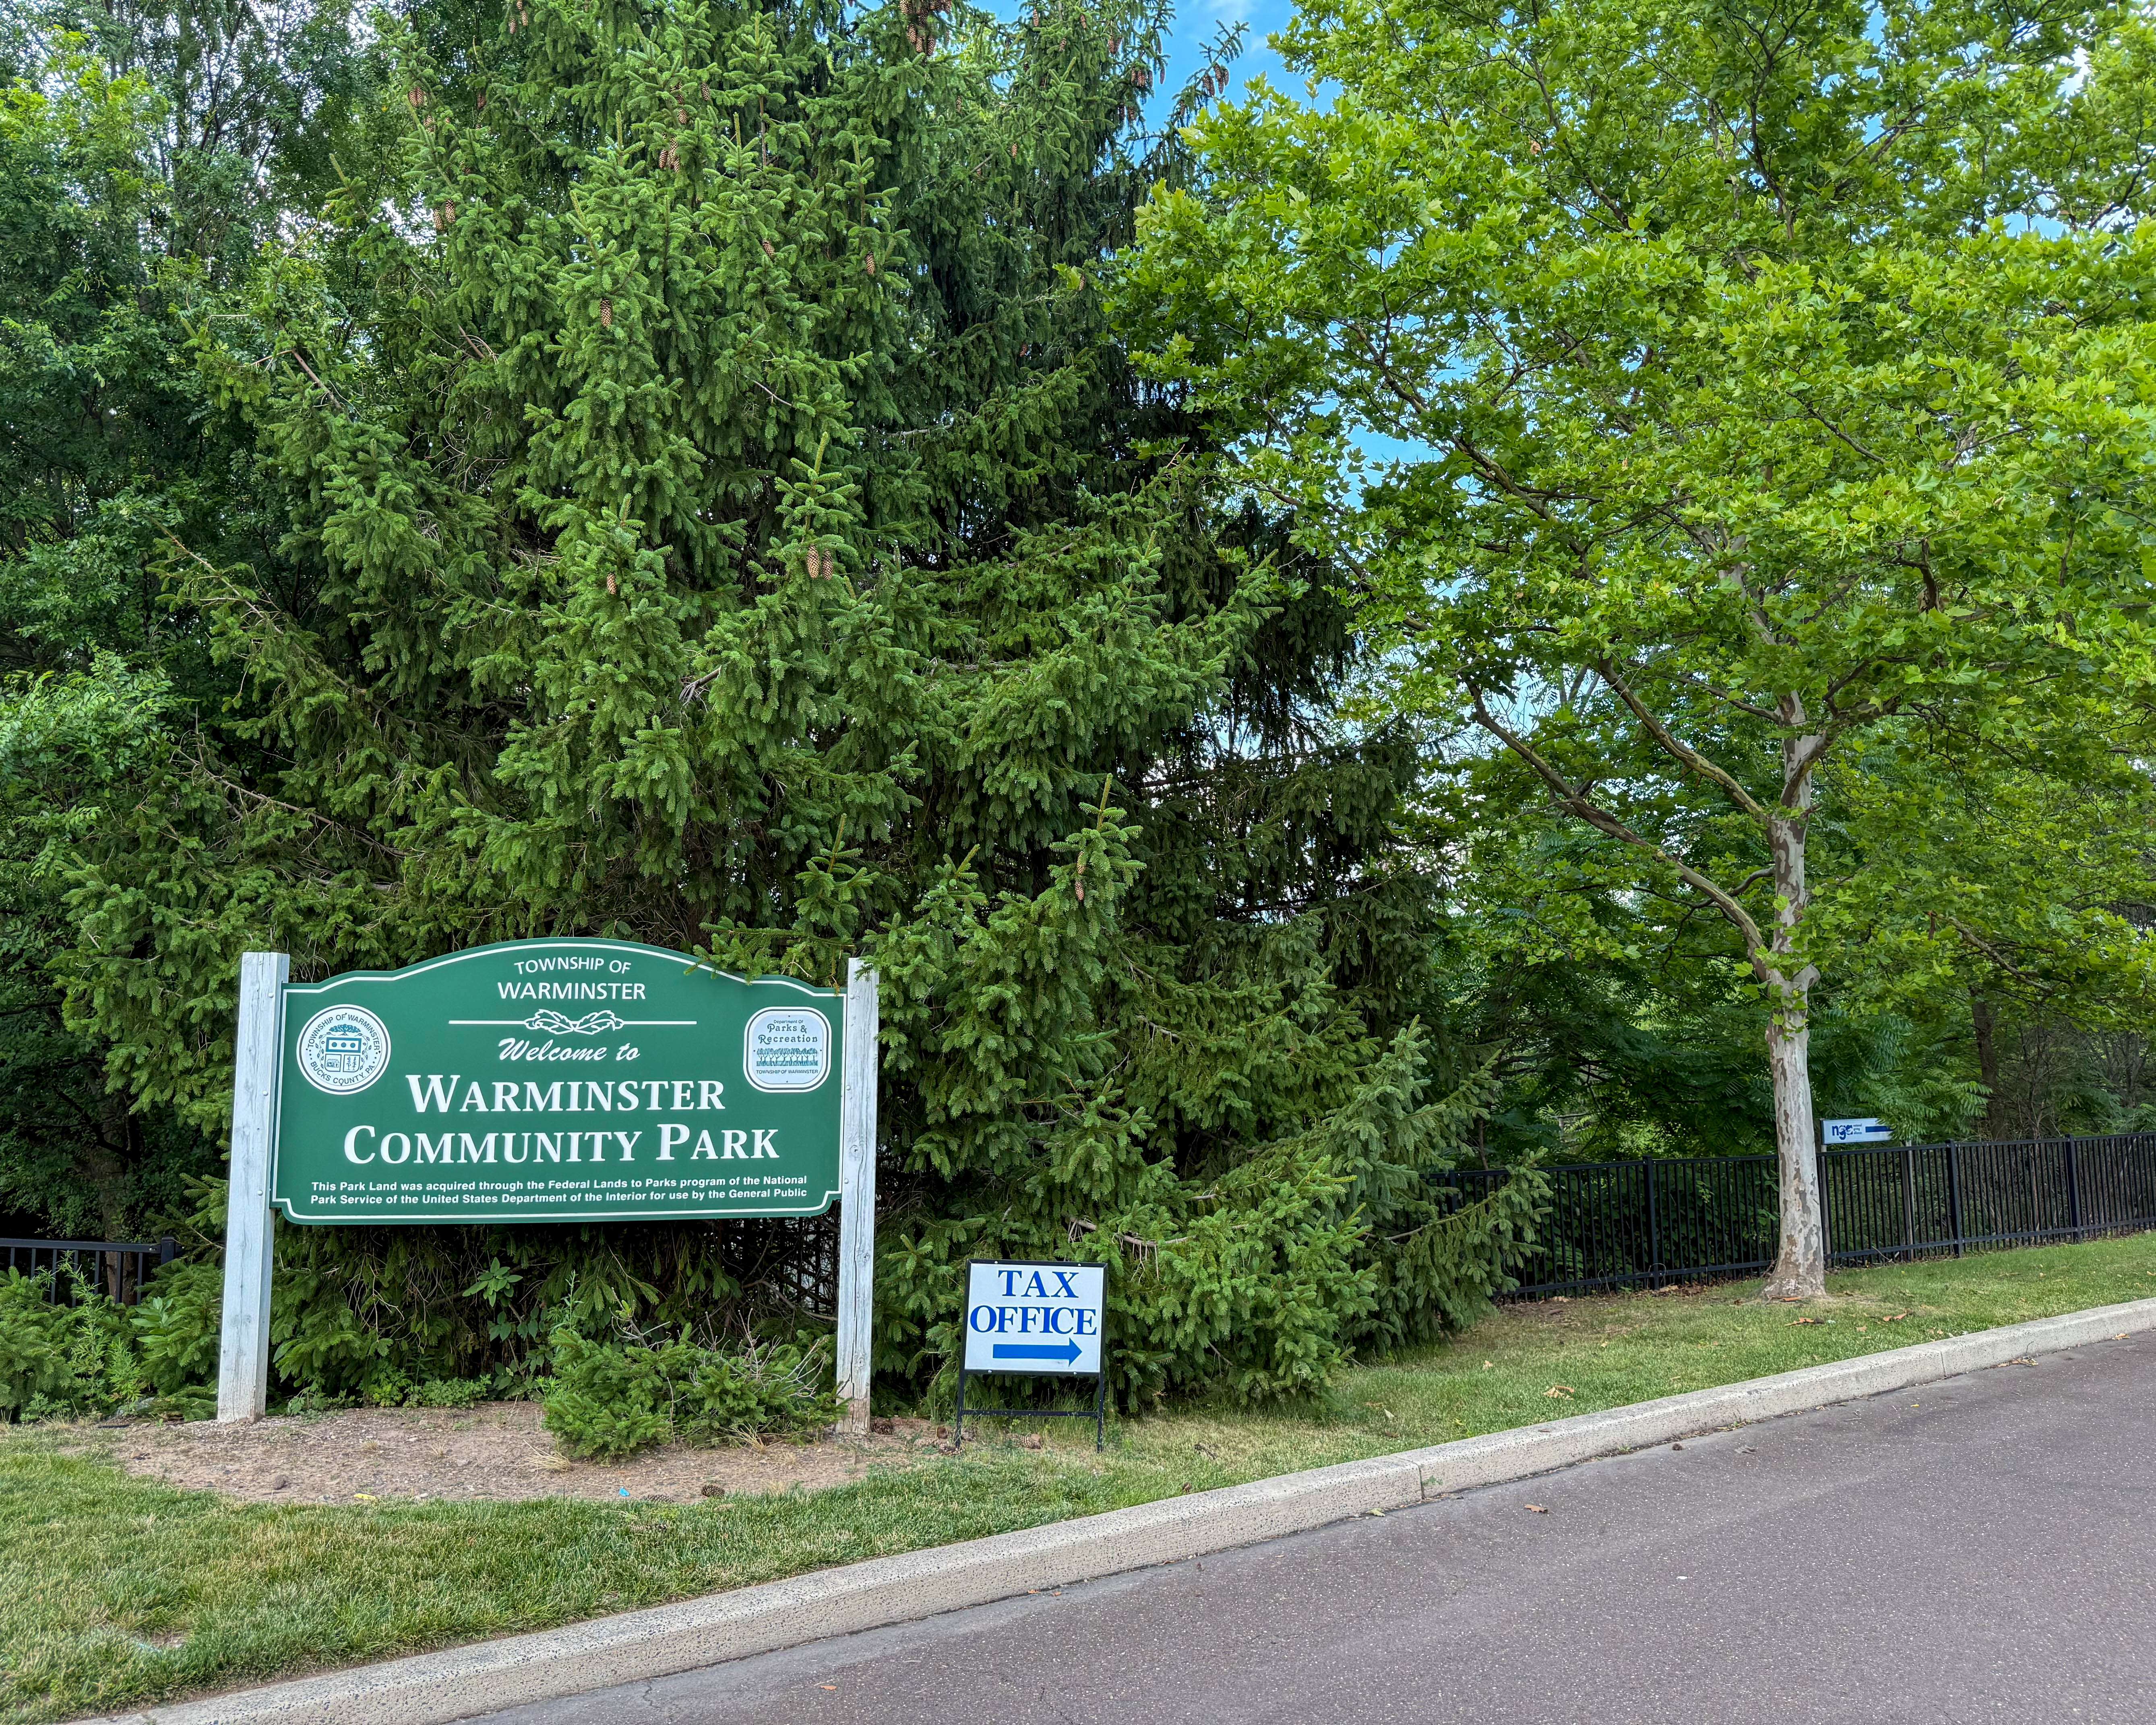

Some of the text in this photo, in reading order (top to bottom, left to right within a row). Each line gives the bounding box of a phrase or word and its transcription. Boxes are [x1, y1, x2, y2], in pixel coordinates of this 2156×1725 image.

[514, 957, 631, 974] TOWNSHIP OF
[498, 982, 646, 999] WARMINSTER
[308, 1016, 333, 1048] TOWNSHIP
[348, 1014, 380, 1051] WARMINSTER
[767, 1024, 807, 1034] Parks &
[498, 1037, 641, 1061] Welcome to
[758, 1034, 818, 1045] Recreation
[310, 1061, 331, 1081] BUCKS
[406, 1075, 726, 1113] WARMINSTER
[344, 1123, 780, 1164] COMMUNITY PARK
[311, 1182, 336, 1191] This
[340, 1182, 365, 1191] Park
[369, 1182, 397, 1191] Land
[426, 1181, 475, 1192] acquired
[479, 1181, 523, 1192] through
[527, 1181, 545, 1189] the
[548, 1180, 590, 1189] Federal
[594, 1179, 628, 1188] Lands
[631, 1179, 642, 1187] to
[645, 1178, 677, 1187] Parks
[680, 1179, 726, 1189] program
[729, 1177, 740, 1185] of
[743, 1176, 760, 1185] the
[763, 1175, 807, 1185] National
[311, 1195, 336, 1204] Park
[340, 1195, 382, 1204] Service
[386, 1195, 397, 1204] of
[401, 1195, 419, 1204] the
[422, 1194, 459, 1204] United
[463, 1194, 498, 1203] States
[502, 1193, 567, 1205] Department
[570, 1193, 581, 1202] of
[585, 1193, 602, 1202] the
[606, 1191, 647, 1201] Interior
[650, 1191, 666, 1200] for
[692, 1190, 705, 1201] by
[708, 1190, 726, 1199] the
[729, 1189, 770, 1198] General
[774, 1188, 807, 1197] Public
[998, 1270, 1079, 1298] TAX
[970, 1305, 1097, 1335] OFFICE
